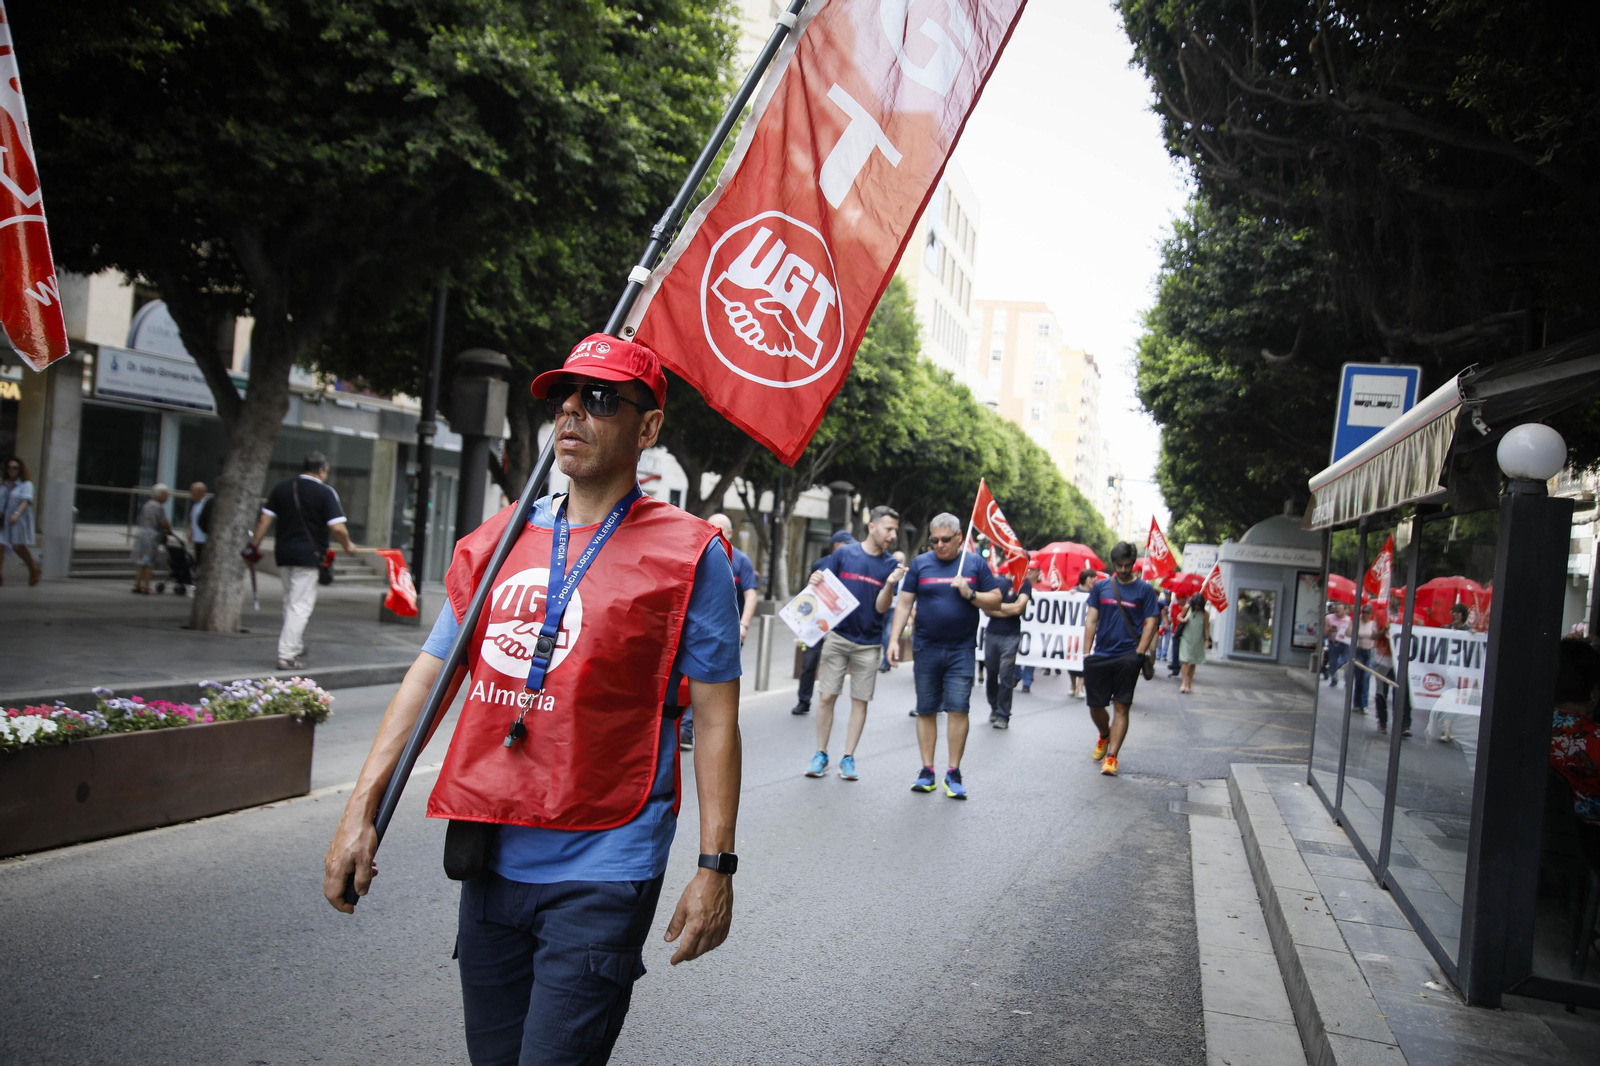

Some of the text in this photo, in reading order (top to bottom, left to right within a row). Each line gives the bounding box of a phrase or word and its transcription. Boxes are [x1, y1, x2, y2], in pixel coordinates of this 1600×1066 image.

[727, 226, 837, 339] UGT
[557, 525, 568, 560] VALENCIA
[558, 511, 620, 600] POLICIA LOCAL VALENCIA
[1040, 632, 1079, 661] YA!!
[469, 680, 556, 712] Almería
